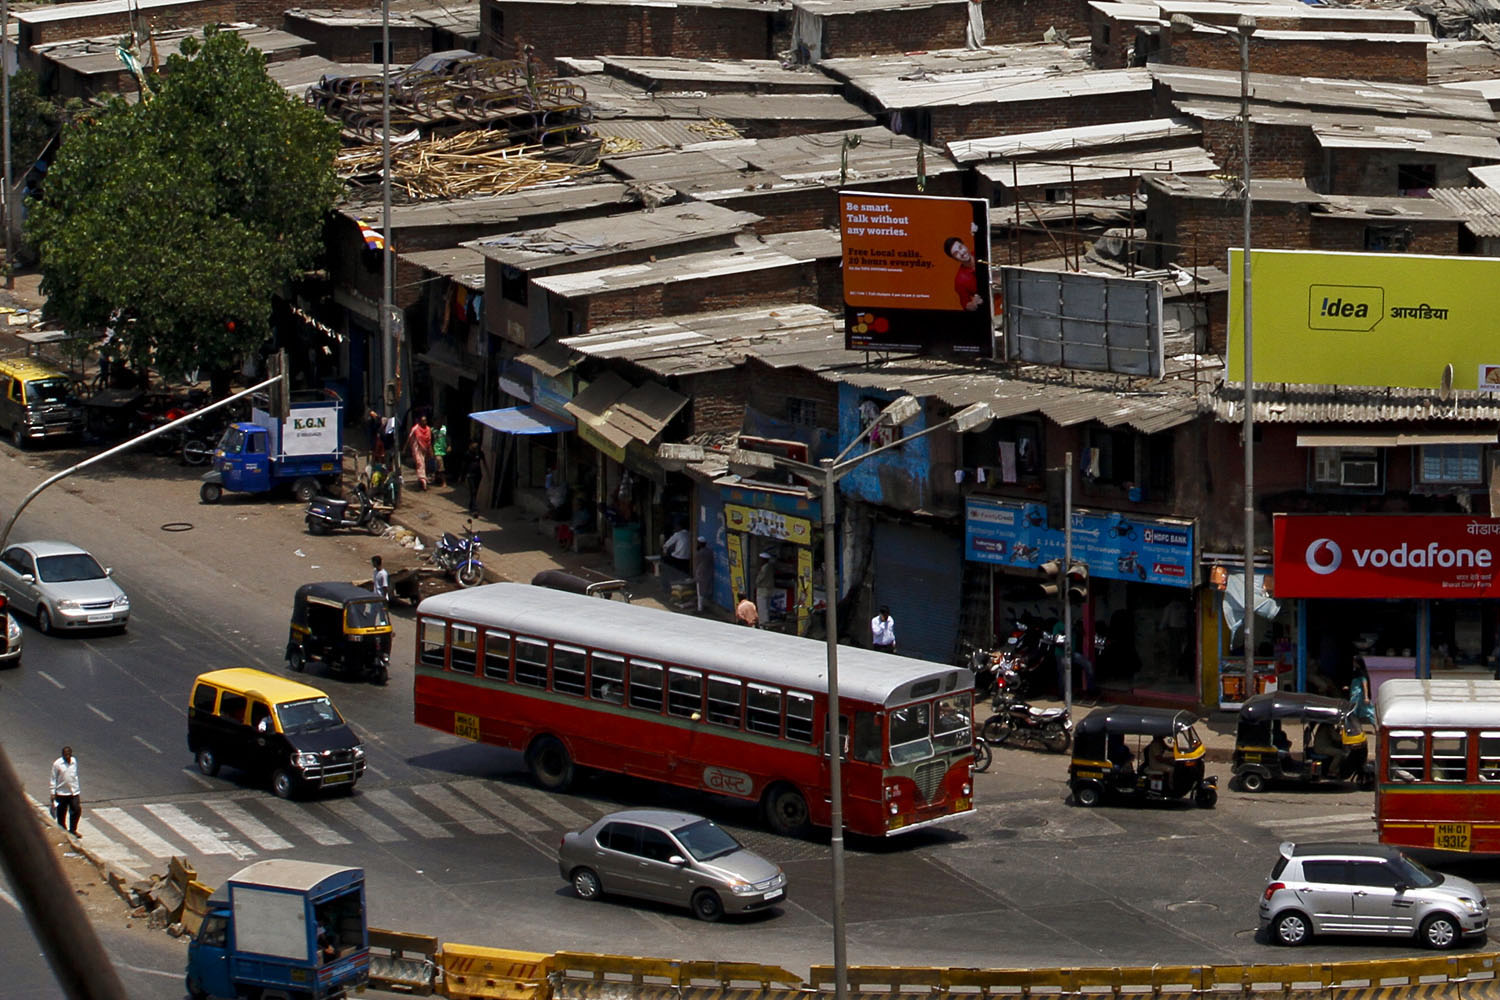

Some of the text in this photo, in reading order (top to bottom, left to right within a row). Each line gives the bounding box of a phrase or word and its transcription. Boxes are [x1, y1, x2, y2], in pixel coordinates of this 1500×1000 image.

[846, 202, 892, 212] Be smart.
[846, 214, 909, 224] Talk without
[847, 227, 908, 236] any worries.
[848, 248, 868, 256] Free
[890, 259, 934, 268] everyday.
[1391, 303, 1448, 320] आयडिया
[294, 417, 326, 429] K.G.N
[1153, 533, 1187, 544] HDFC BANK
[1352, 542, 1492, 568] vodafone
[1461, 581, 1476, 589] Dairy
[711, 769, 746, 792] बेस्ट
